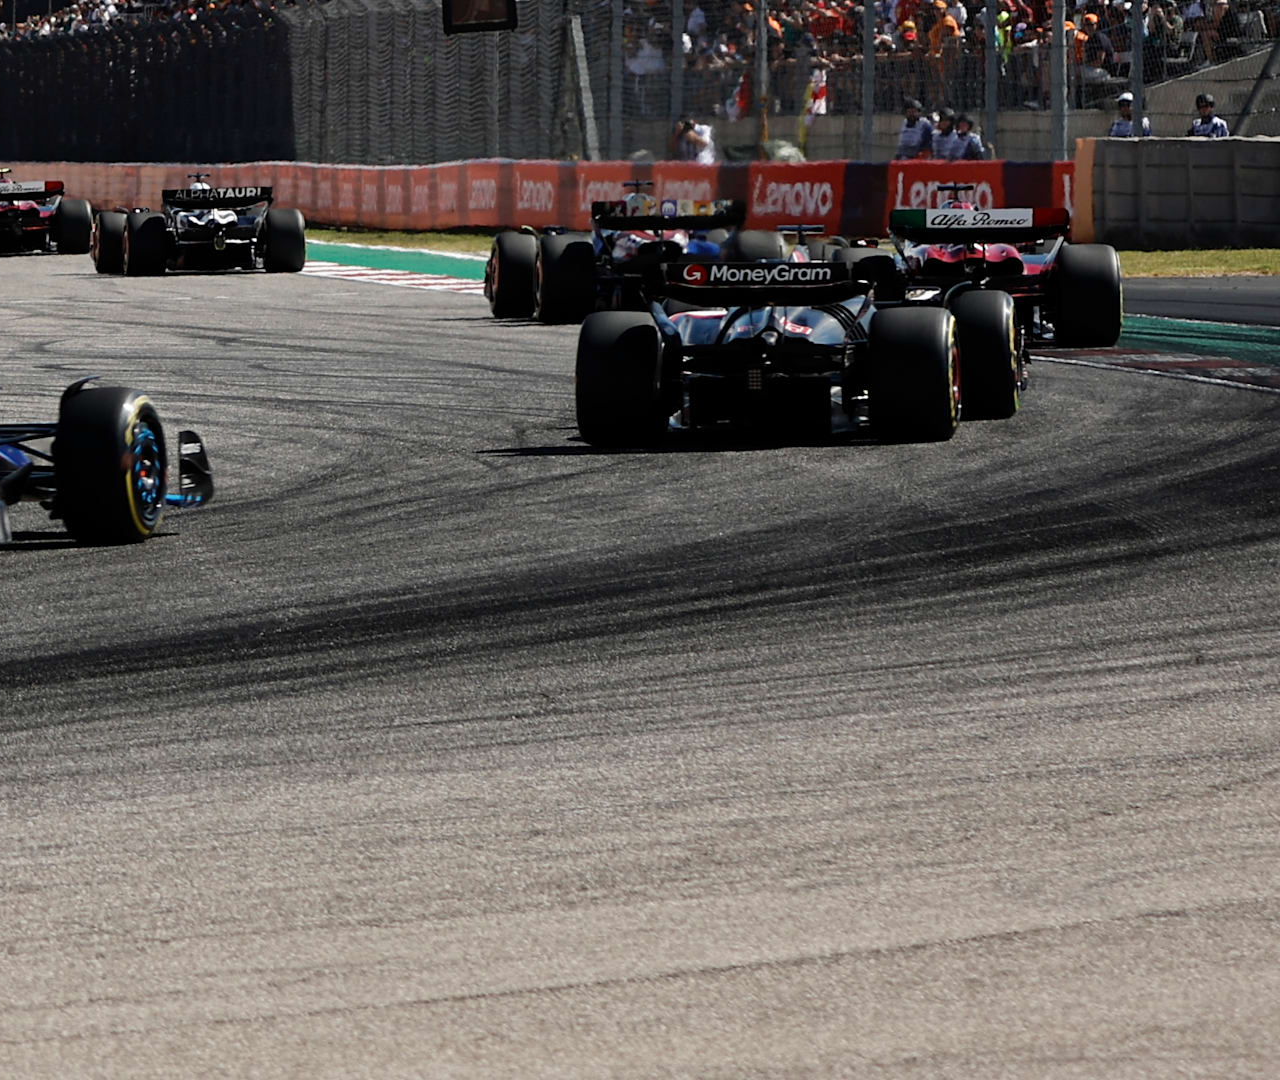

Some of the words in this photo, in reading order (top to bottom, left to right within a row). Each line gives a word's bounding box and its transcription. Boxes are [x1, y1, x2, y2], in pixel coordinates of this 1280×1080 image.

[175, 187, 261, 200] ALPHATAURI
[516, 171, 555, 212] Lenovo
[753, 173, 834, 218] Lenovo
[930, 213, 967, 229] Alfa
[971, 212, 1030, 226] Romeo
[710, 264, 831, 284] MoneyGram
